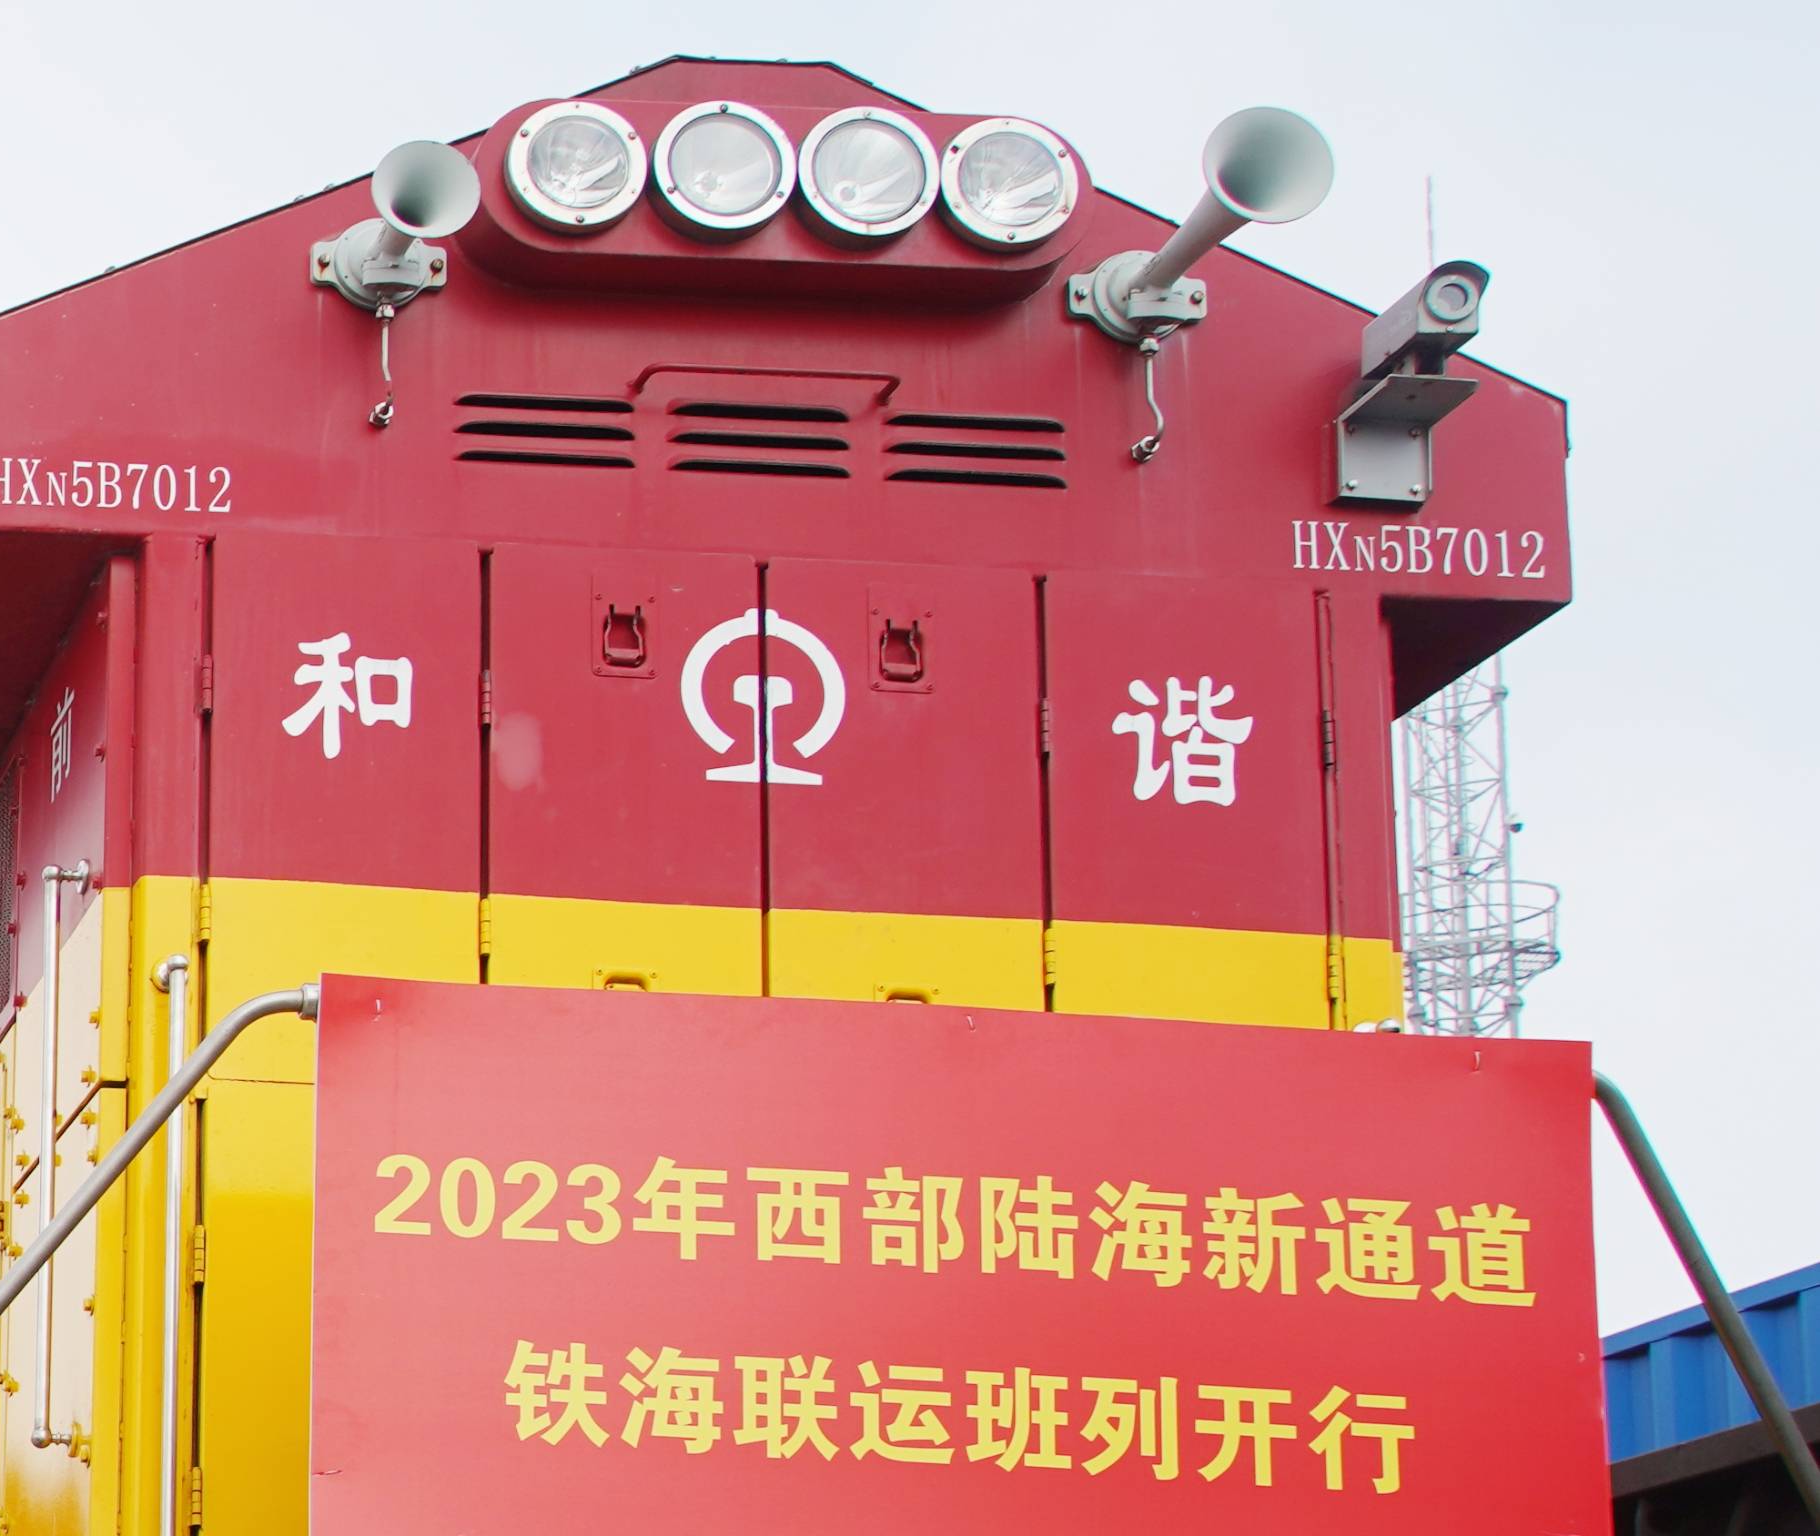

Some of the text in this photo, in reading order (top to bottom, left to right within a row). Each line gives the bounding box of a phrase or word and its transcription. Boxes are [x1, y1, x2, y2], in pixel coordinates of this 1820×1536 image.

[281, 632, 1253, 807] 和 谐
[374, 1154, 1538, 1308] 2023年西部陆海新通道
[505, 1341, 1416, 1495] 铁海联运班列开行
